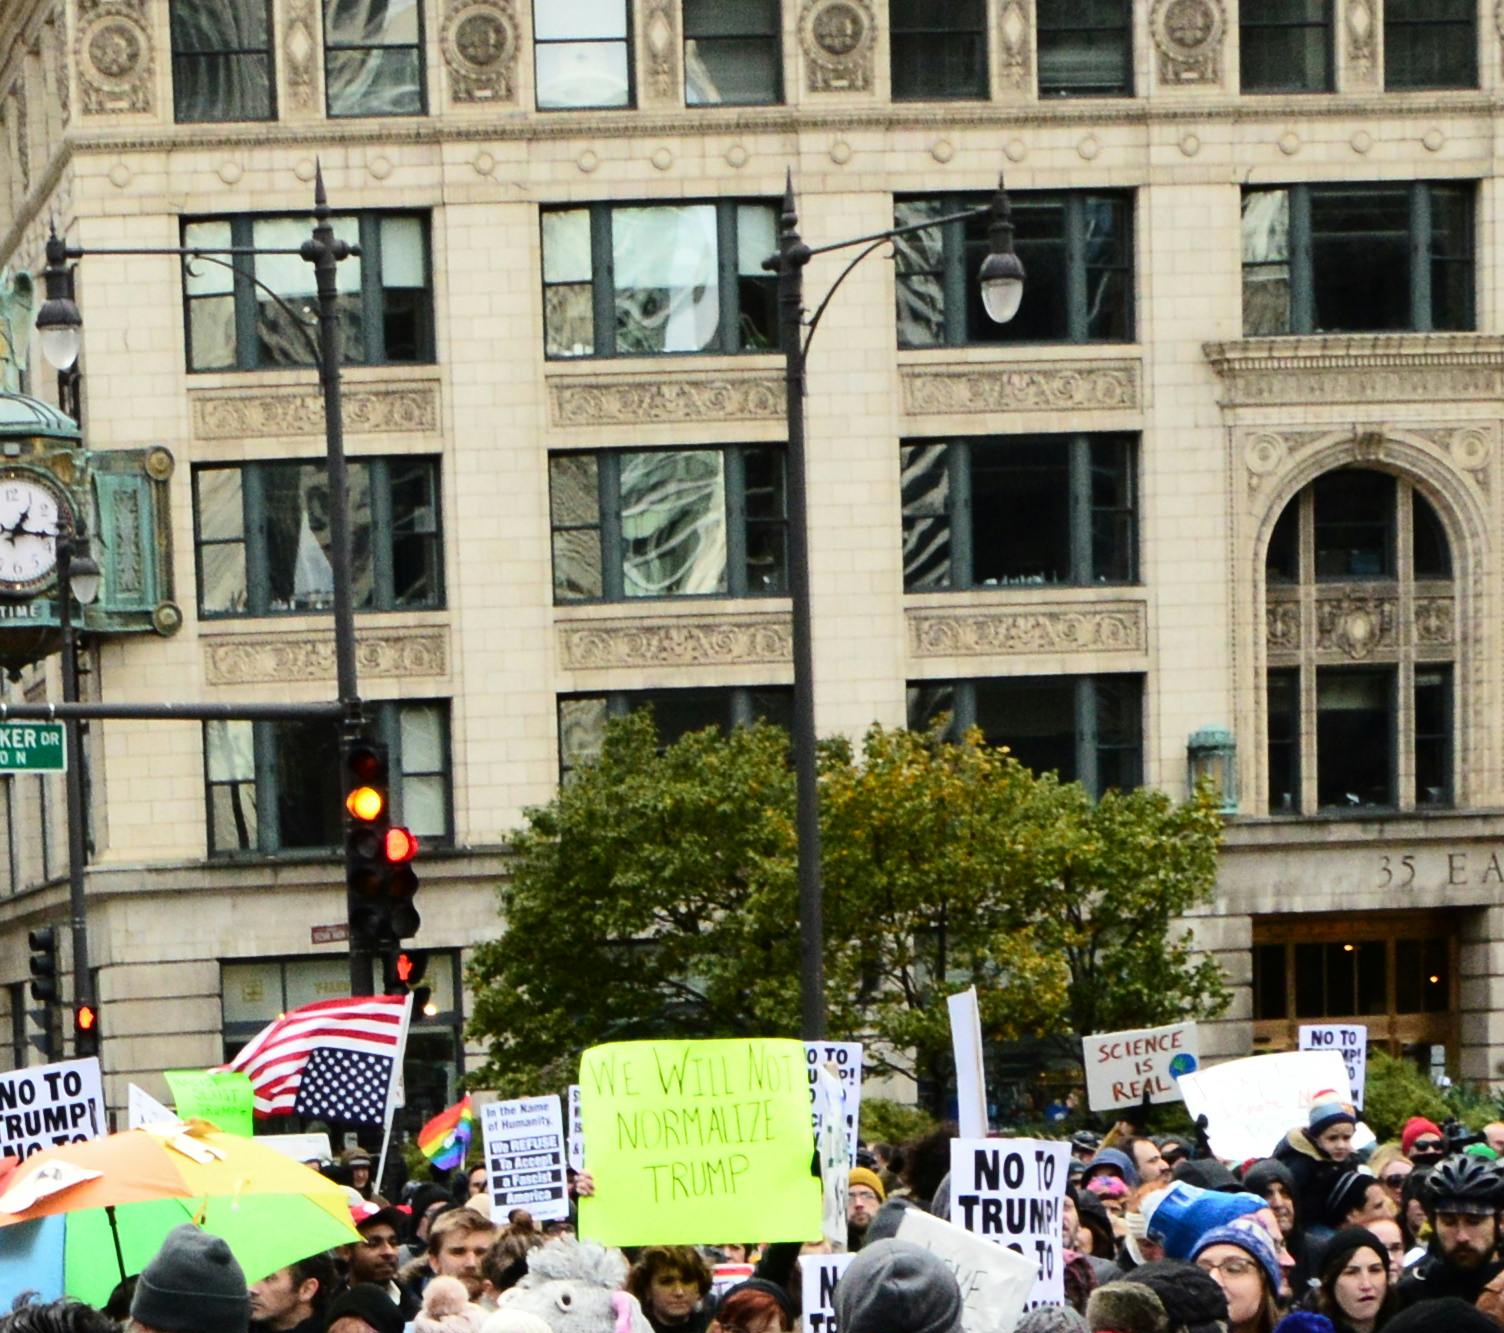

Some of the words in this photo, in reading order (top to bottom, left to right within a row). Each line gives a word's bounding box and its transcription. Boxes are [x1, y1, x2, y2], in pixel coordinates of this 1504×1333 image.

[41, 732, 60, 745] DR
[17, 751, 27, 765] N
[1379, 855, 1416, 888] 35
[1098, 1030, 1183, 1063] SCIENCE
[1311, 1031, 1334, 1046] NO
[1340, 1030, 1357, 1045] TO
[589, 1055, 645, 1098] WE
[653, 1048, 734, 1096] WILL
[748, 1045, 795, 1094] NOT
[1136, 1058, 1153, 1076] IS
[42, 1070, 82, 1100] TO
[1112, 1077, 1170, 1102] REAL
[617, 1100, 776, 1150] NORMALIZE
[644, 1154, 751, 1203] TRUMP
[974, 1150, 1024, 1190] NO
[1035, 1150, 1055, 1191] TO
[958, 1195, 1059, 1237] TRUMP!
